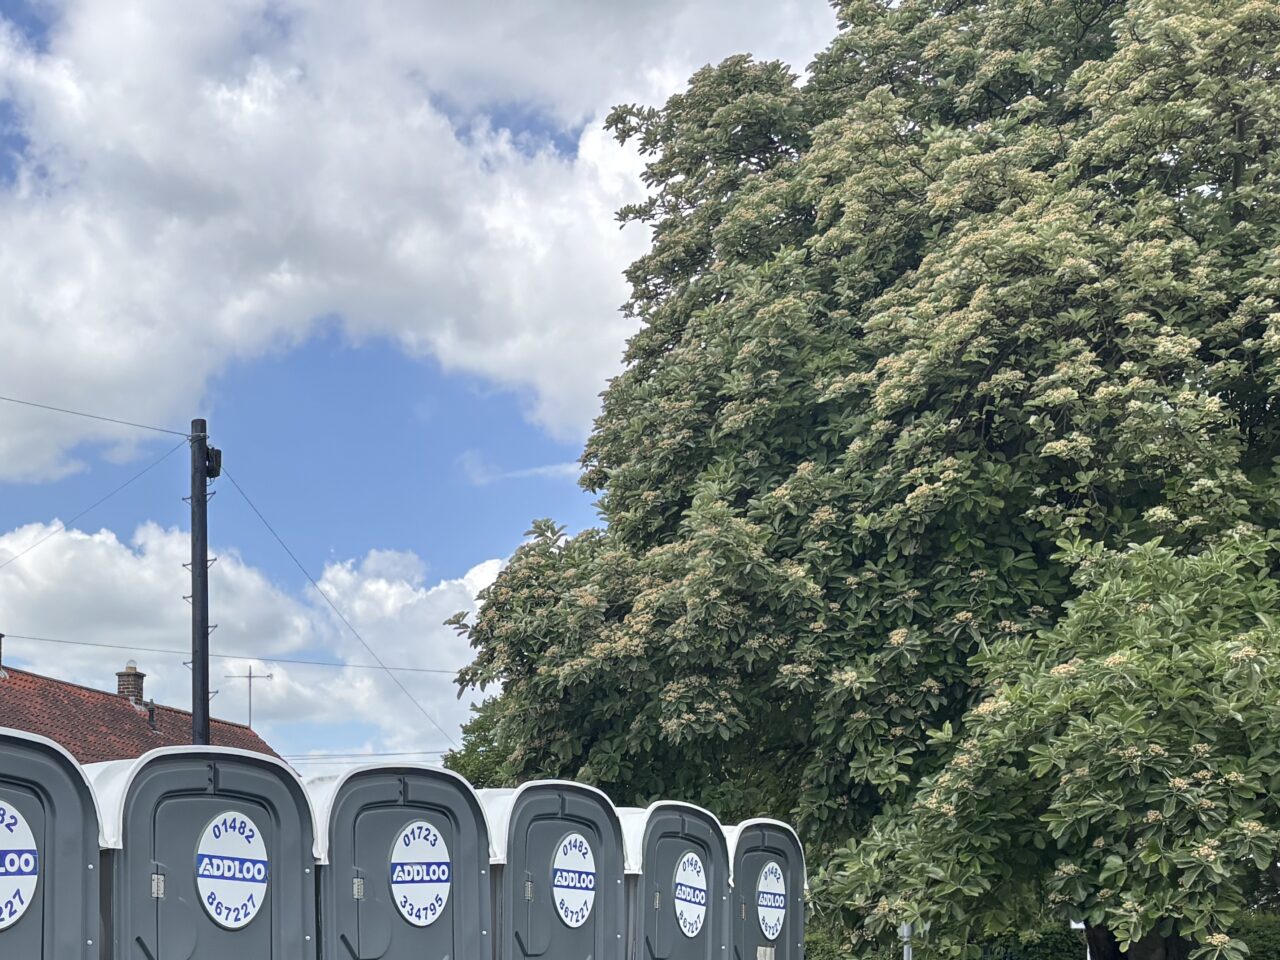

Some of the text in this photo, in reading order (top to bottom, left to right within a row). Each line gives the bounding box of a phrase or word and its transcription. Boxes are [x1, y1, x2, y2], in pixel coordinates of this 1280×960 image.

[213, 817, 255, 844] 01482
[403, 826, 438, 847] 01723
[562, 838, 588, 859] 01482
[199, 858, 265, 880] ADDLOO
[393, 864, 449, 881] ADDLOO
[682, 857, 701, 877] 01482
[554, 870, 595, 888] ADDLOO
[676, 884, 705, 904] ADDLOO
[758, 893, 784, 907] ADDLOO
[207, 891, 256, 922] 867227
[400, 894, 443, 920] 334795
[559, 898, 589, 923] 867227
